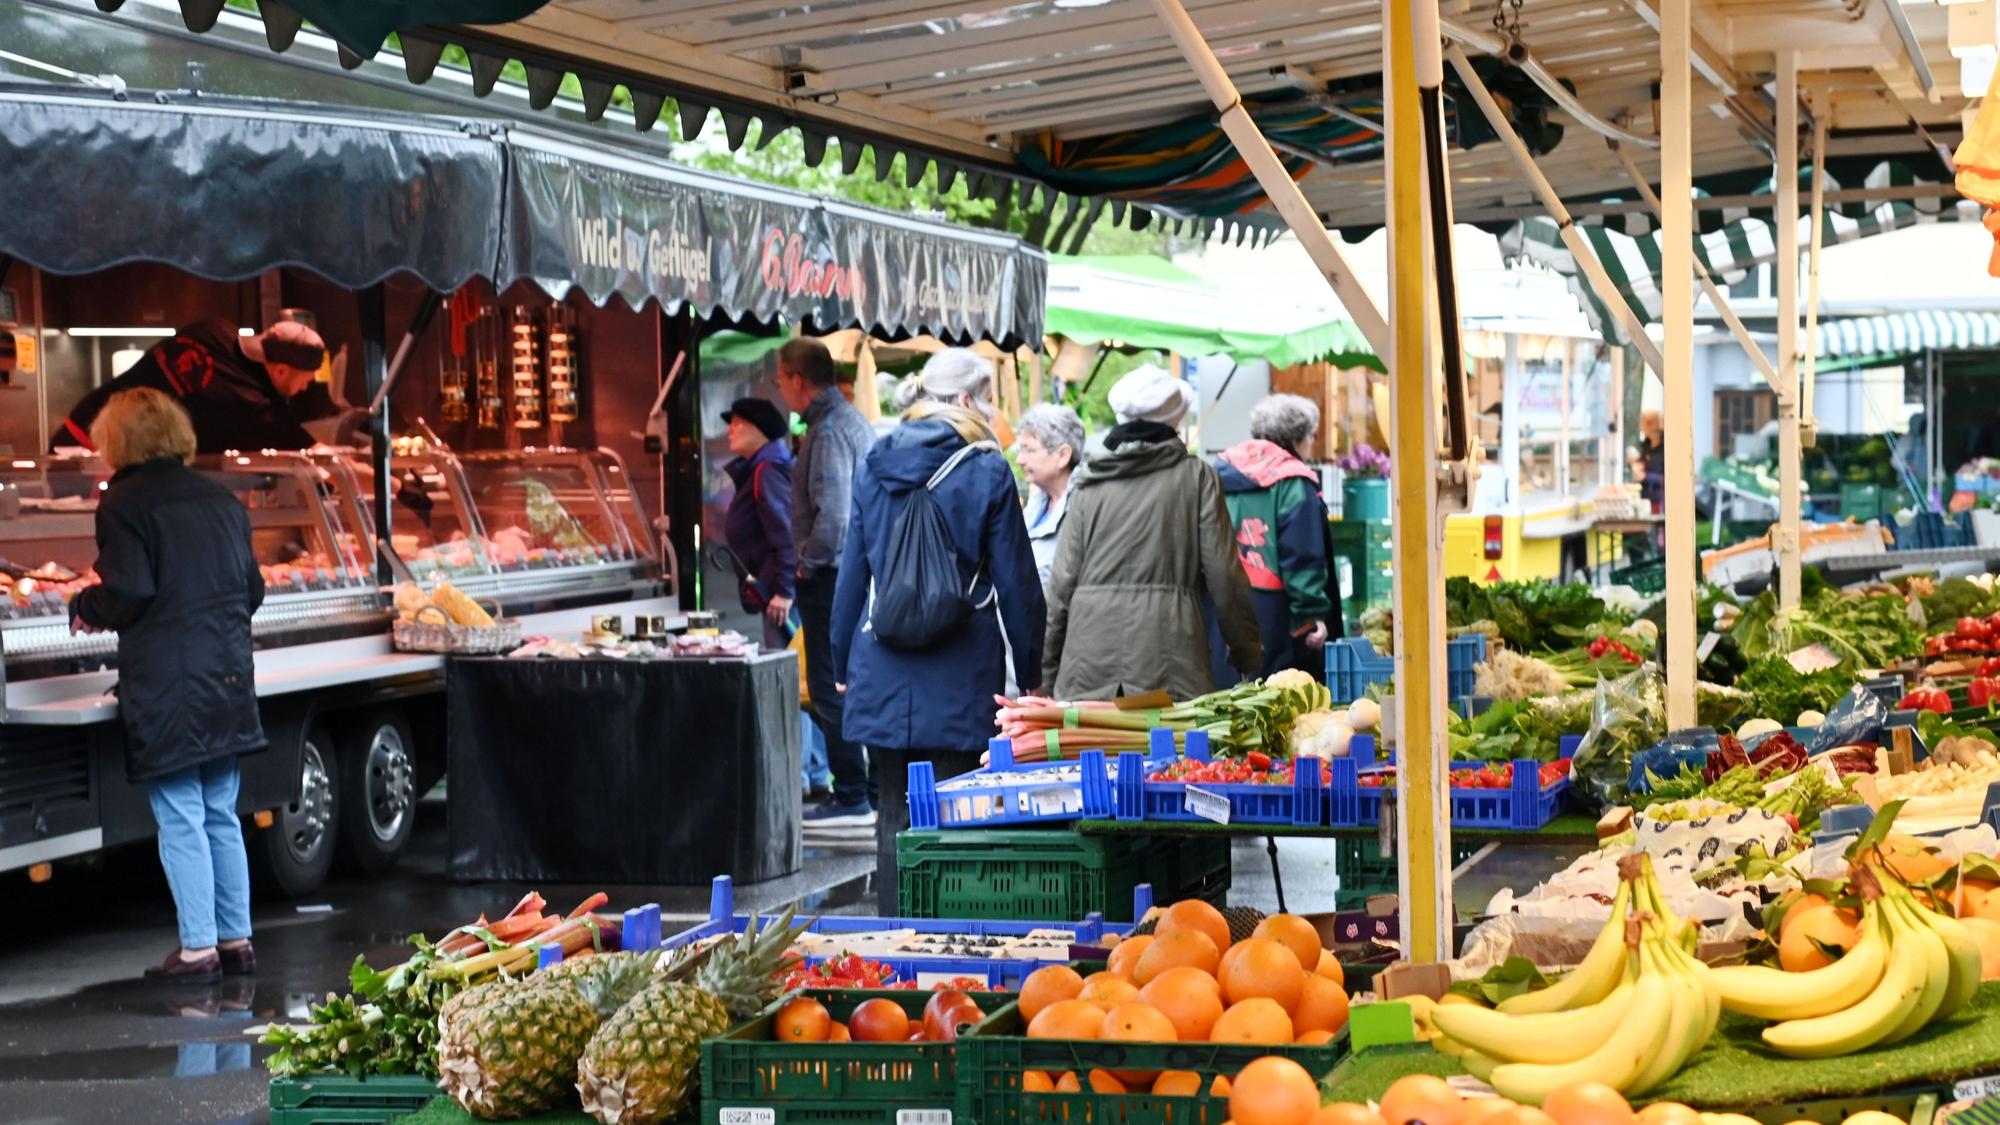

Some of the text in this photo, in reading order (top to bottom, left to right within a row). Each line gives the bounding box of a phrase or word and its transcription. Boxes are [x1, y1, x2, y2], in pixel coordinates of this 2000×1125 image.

[577, 216, 622, 269] Wild
[648, 229, 713, 293] Geflügel
[755, 1111, 771, 1121] 104
